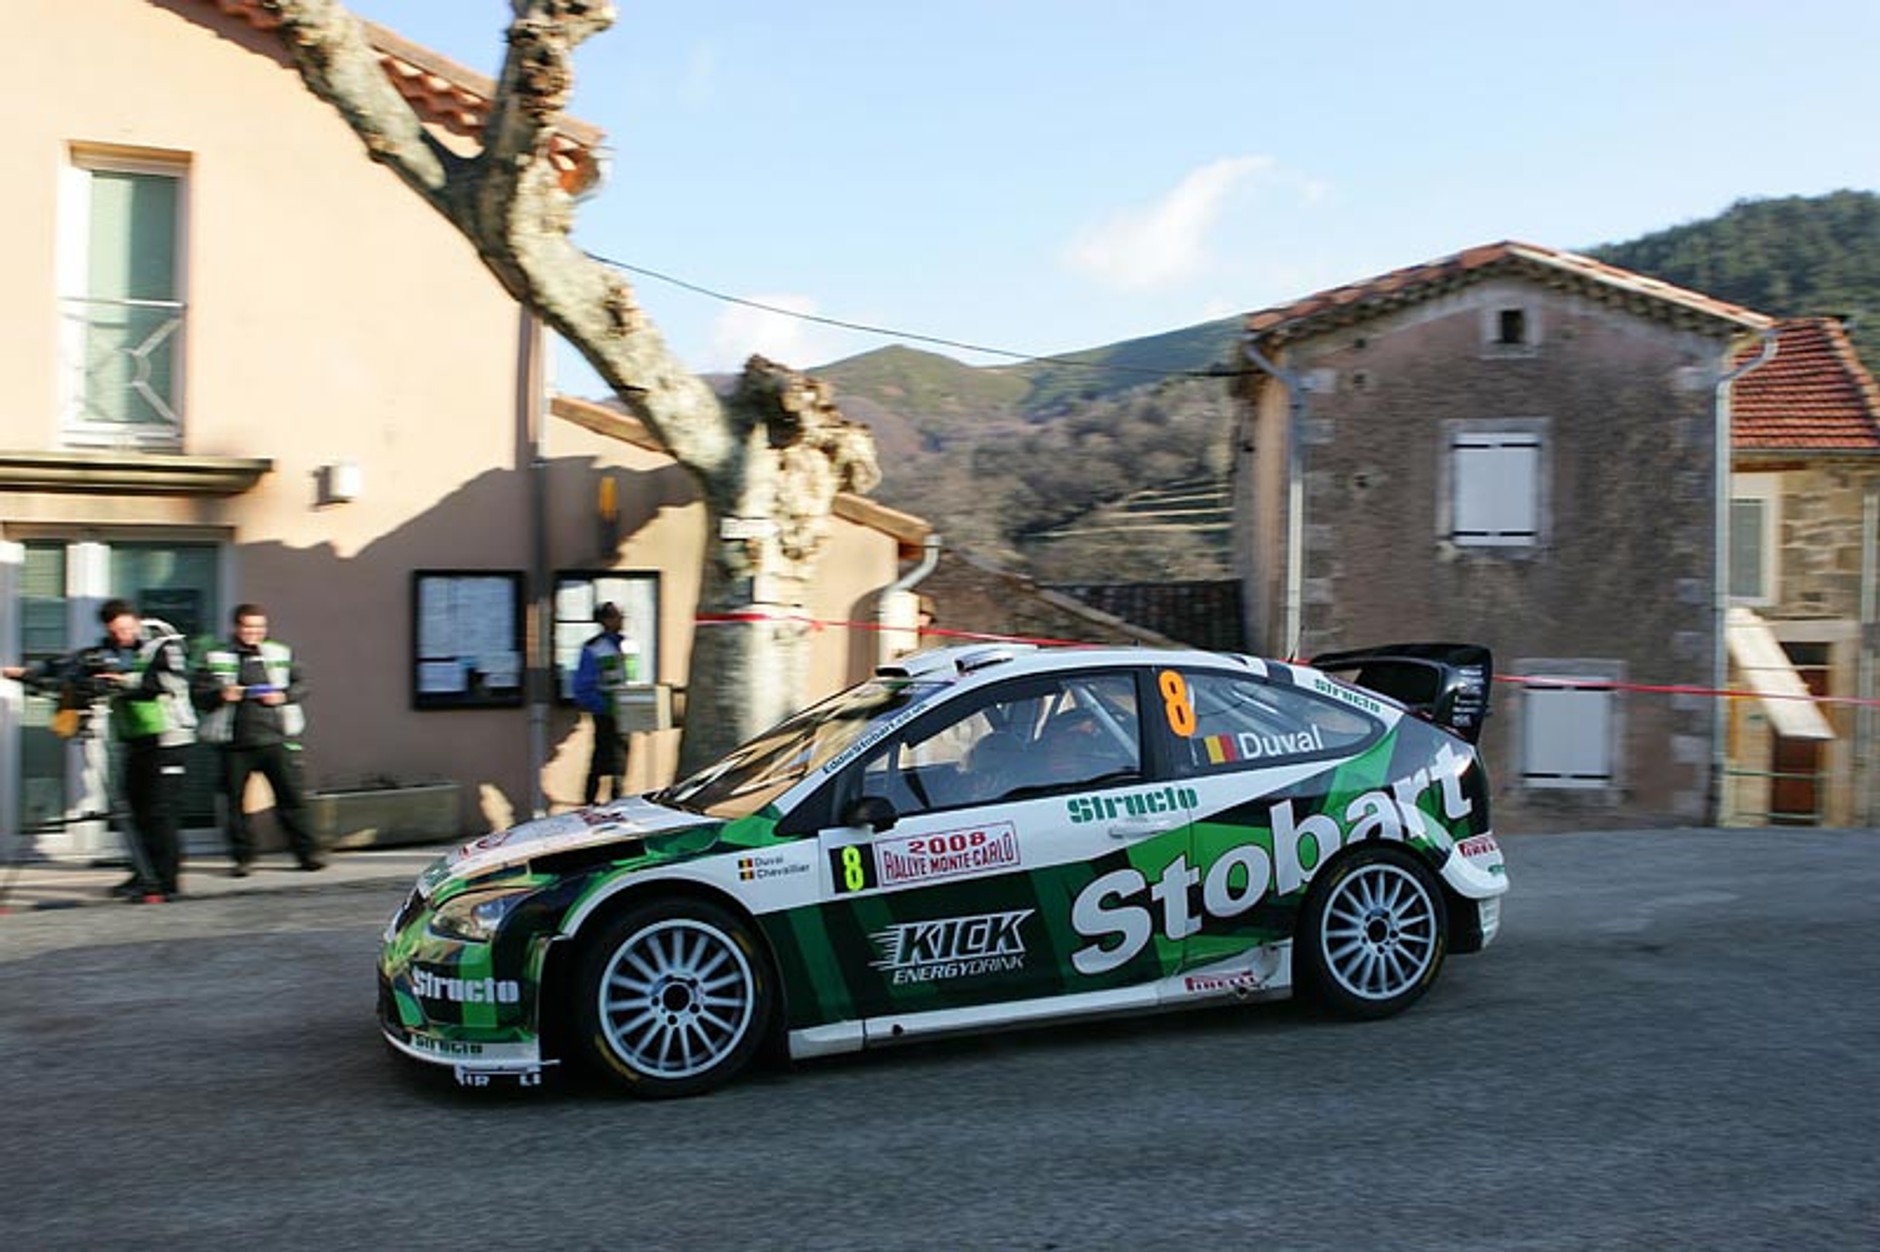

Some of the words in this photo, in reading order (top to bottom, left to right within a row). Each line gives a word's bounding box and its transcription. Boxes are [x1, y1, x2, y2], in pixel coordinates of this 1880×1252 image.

[1158, 669, 1196, 738] 8
[1237, 723, 1324, 760] Duval
[1066, 786, 1198, 824] Structo
[907, 831, 986, 855] 2008
[1071, 742, 1473, 975] Stobart
[841, 844, 865, 892] 8
[883, 850, 928, 881] RALLYE
[893, 908, 1035, 967] KICK
[411, 964, 520, 1004] Structo
